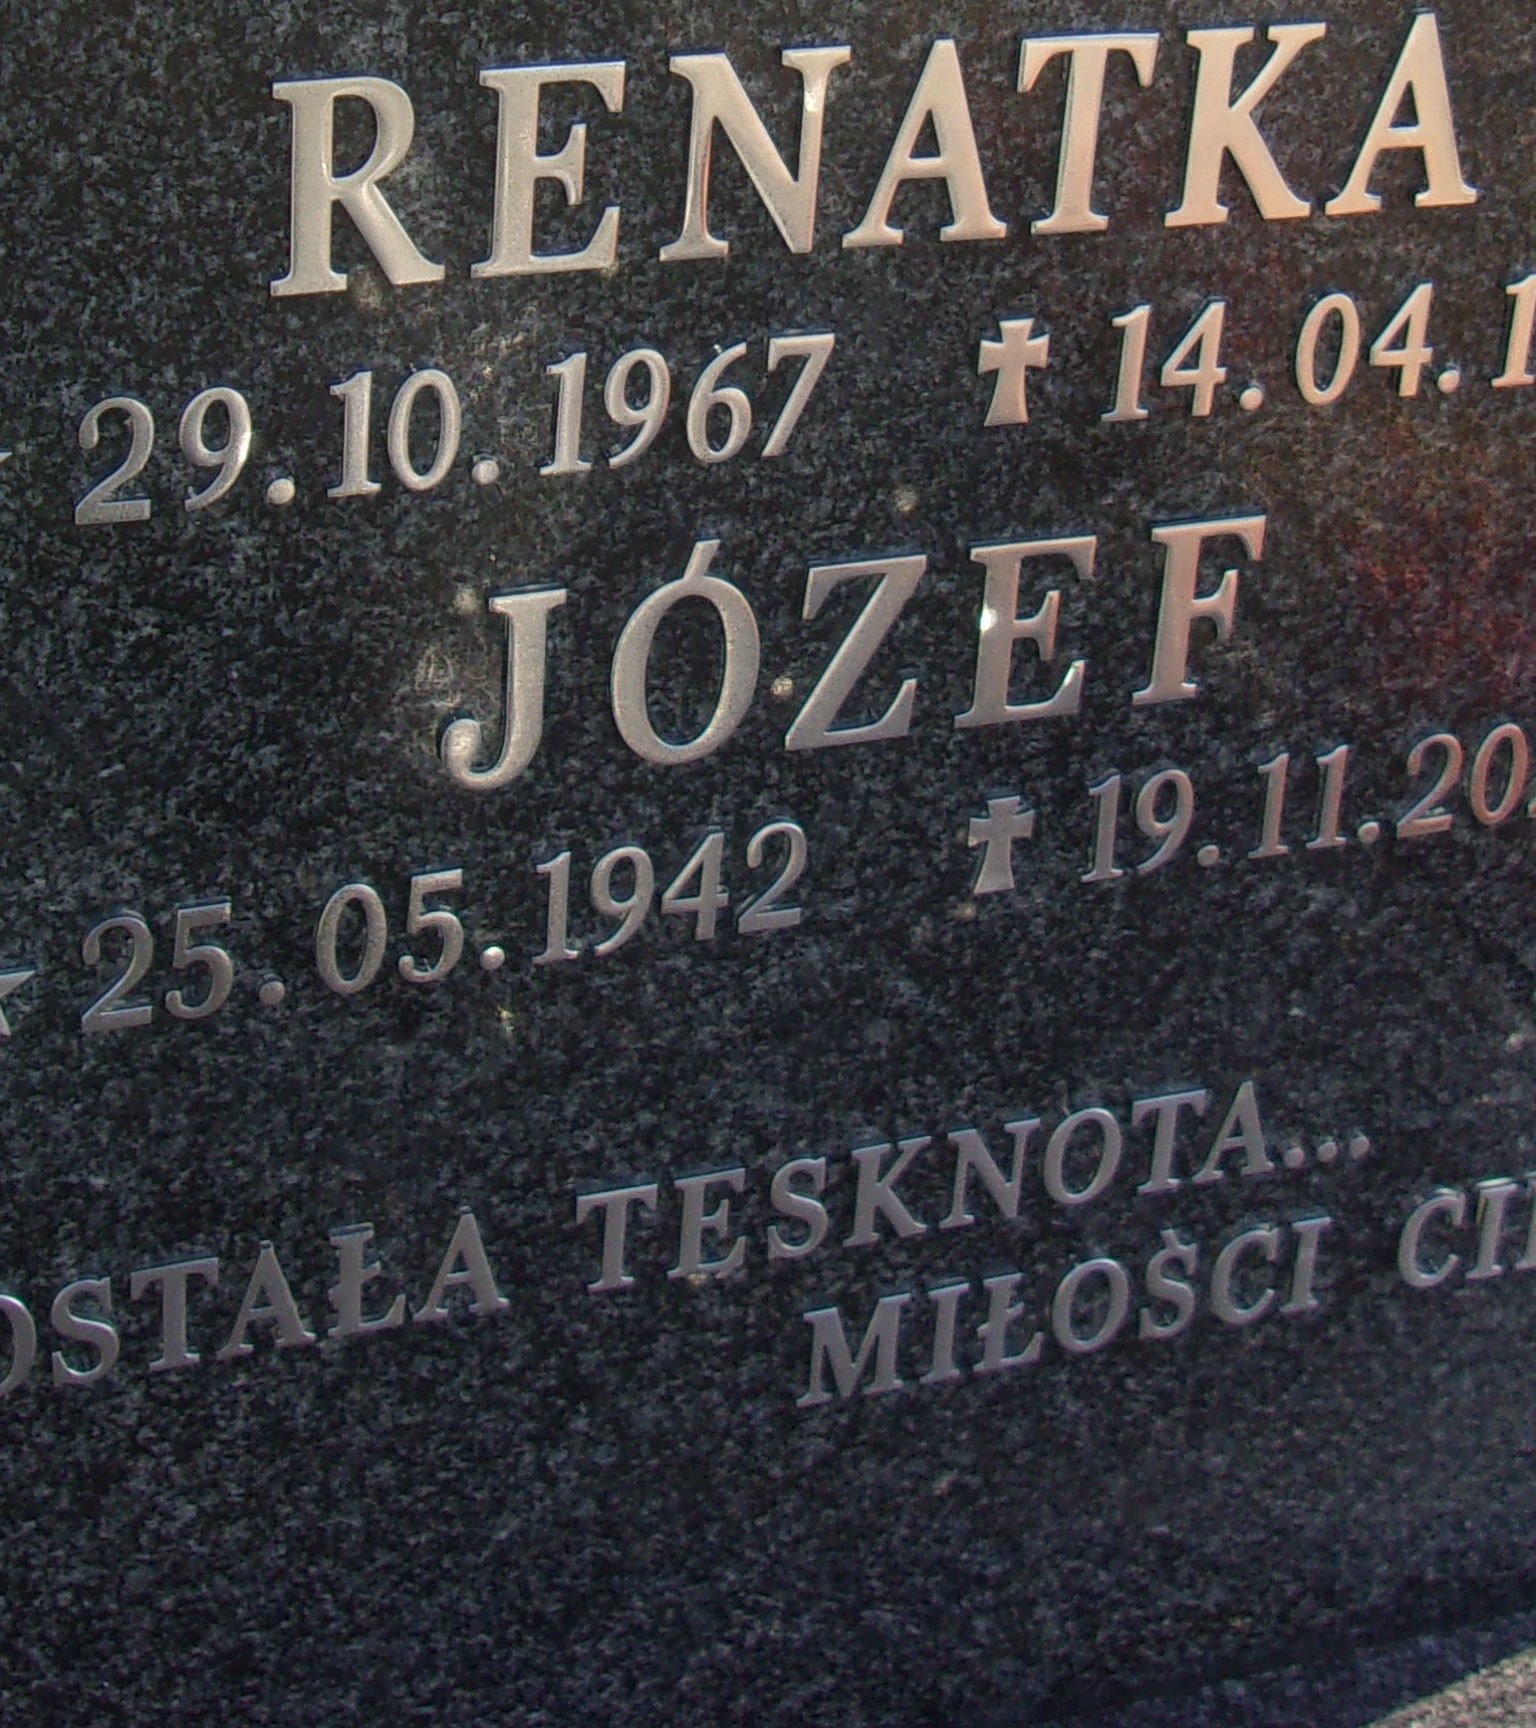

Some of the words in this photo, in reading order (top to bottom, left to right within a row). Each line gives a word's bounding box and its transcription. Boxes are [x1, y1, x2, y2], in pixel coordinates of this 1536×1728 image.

[268, 10, 1480, 297] RENATKA
[75, 328, 838, 527] 29.10.1967
[442, 512, 1267, 794] JÓZEF
[78, 822, 811, 1034] 25.05.1942
[575, 1080, 1371, 1294] TESKNOTA...
[794, 1214, 1332, 1408] MIŁOŚCI
